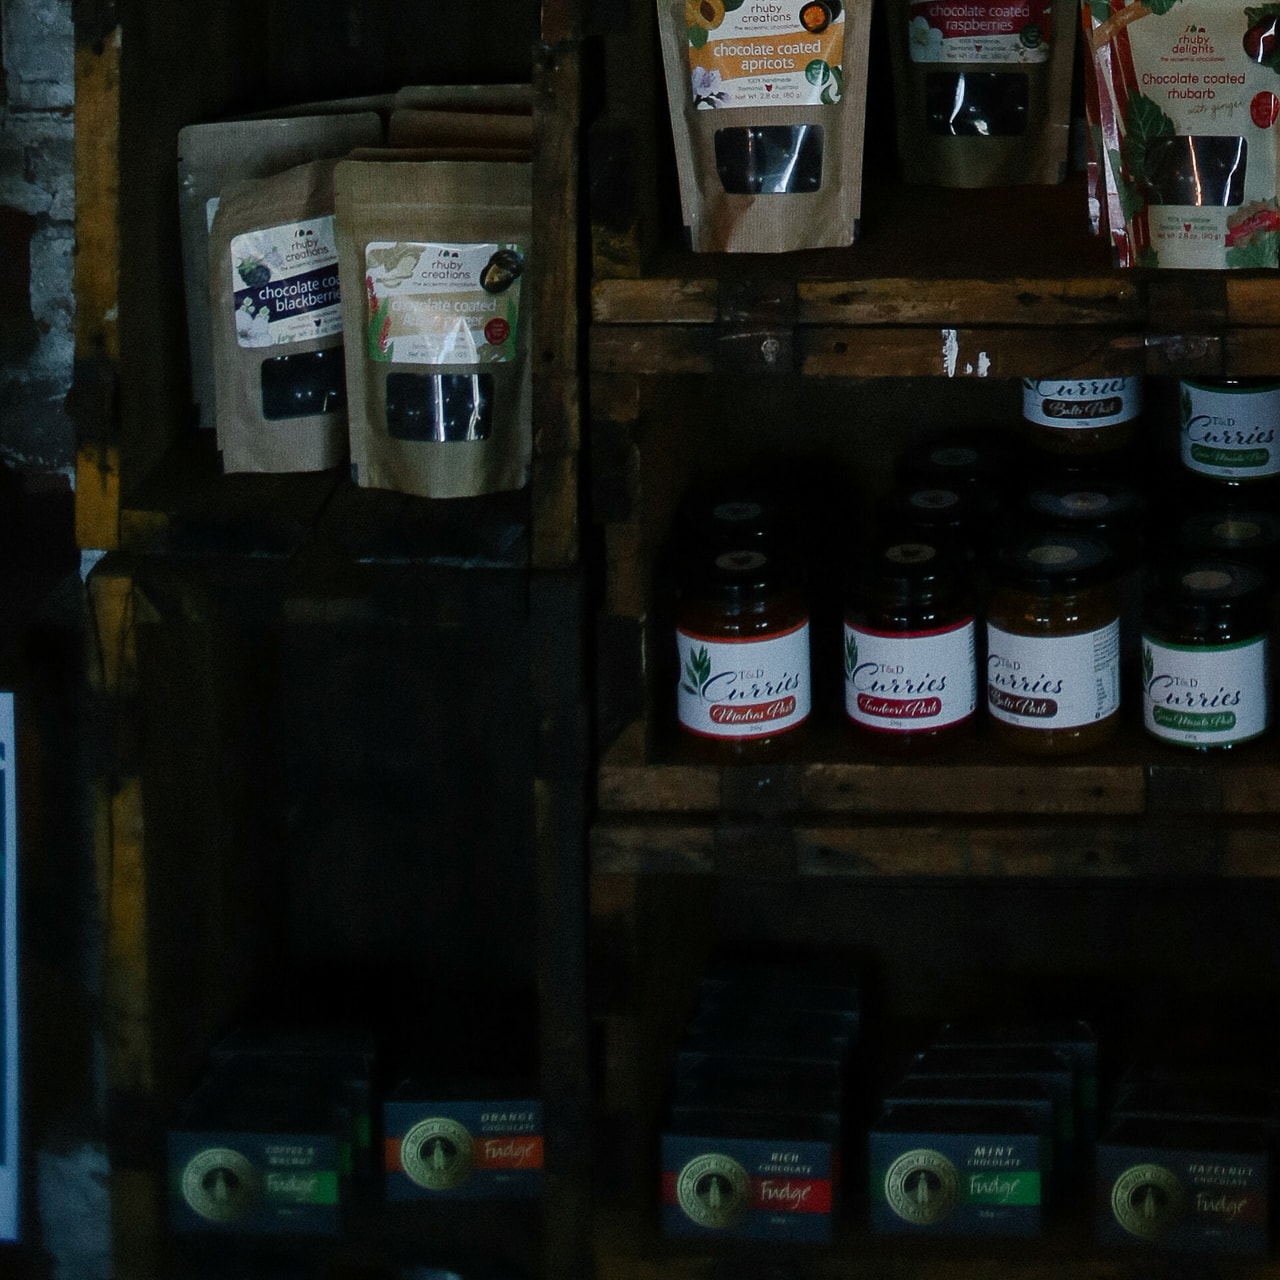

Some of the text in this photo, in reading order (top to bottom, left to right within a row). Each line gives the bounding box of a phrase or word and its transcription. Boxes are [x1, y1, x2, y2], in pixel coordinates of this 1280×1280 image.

[751, 3, 783, 14] rhuby
[929, 4, 1030, 18] chocolate coated
[741, 12, 791, 23] creations
[945, 18, 1014, 33] raspberries
[1178, 34, 1210, 45] rhuby
[713, 40, 822, 57] chocolate coated
[1172, 44, 1214, 55] delights
[741, 57, 795, 73] apricots
[1142, 73, 1246, 85] Chocolate coated
[1167, 87, 1216, 99] rhubarb
[291, 238, 319, 251] rhuby
[285, 245, 329, 262] creations
[431, 260, 464, 271] rhuby
[421, 270, 471, 279] creations
[259, 280, 320, 300] chocolate
[454, 298, 497, 312] coated
[1212, 417, 1235, 427] T&D
[1187, 415, 1275, 445] Curries
[879, 663, 904, 674] T&D
[1001, 659, 1021, 671] T&D
[739, 669, 764, 680] T&D
[852, 662, 947, 695] Curries
[987, 654, 1064, 694] Curries
[702, 671, 800, 702] Curries
[1174, 677, 1199, 687] T&D
[1149, 674, 1242, 708] Curries
[860, 695, 904, 715] Tandoori
[712, 707, 764, 723] Madras
[480, 1111, 535, 1123] ORANGE
[483, 1140, 536, 1166] Fudge
[770, 1151, 800, 1165] RICH
[974, 1145, 1015, 1159] MINT
[758, 1163, 812, 1175] CHOCOLATE
[967, 1157, 1023, 1168] CHOCOLATE
[1189, 1163, 1254, 1177] HAZELNUT
[265, 1172, 317, 1196] Fudge
[970, 1173, 1022, 1202] Fudge
[760, 1180, 812, 1209] Fudge
[1196, 1192, 1248, 1223] Fudge
